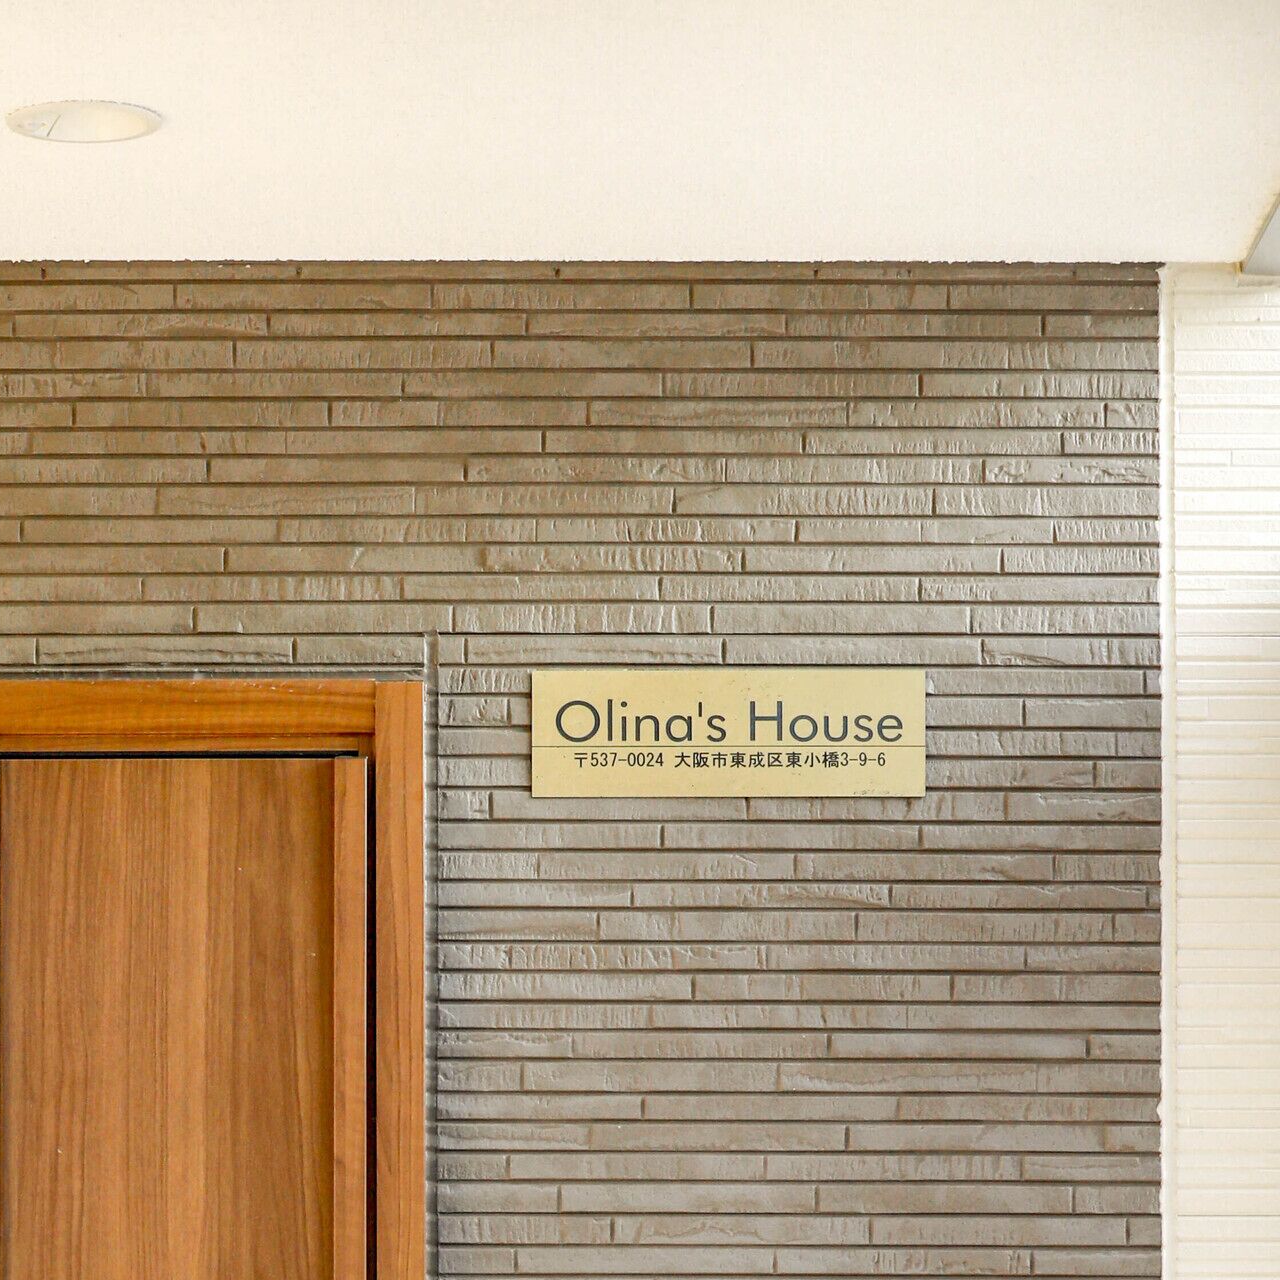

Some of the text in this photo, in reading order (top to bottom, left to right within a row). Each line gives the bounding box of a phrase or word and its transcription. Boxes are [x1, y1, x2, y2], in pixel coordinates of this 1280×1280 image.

[555, 698, 903, 743] Olina's House
[674, 751, 887, 769] 大阪市東成区東小橋3-9-6
